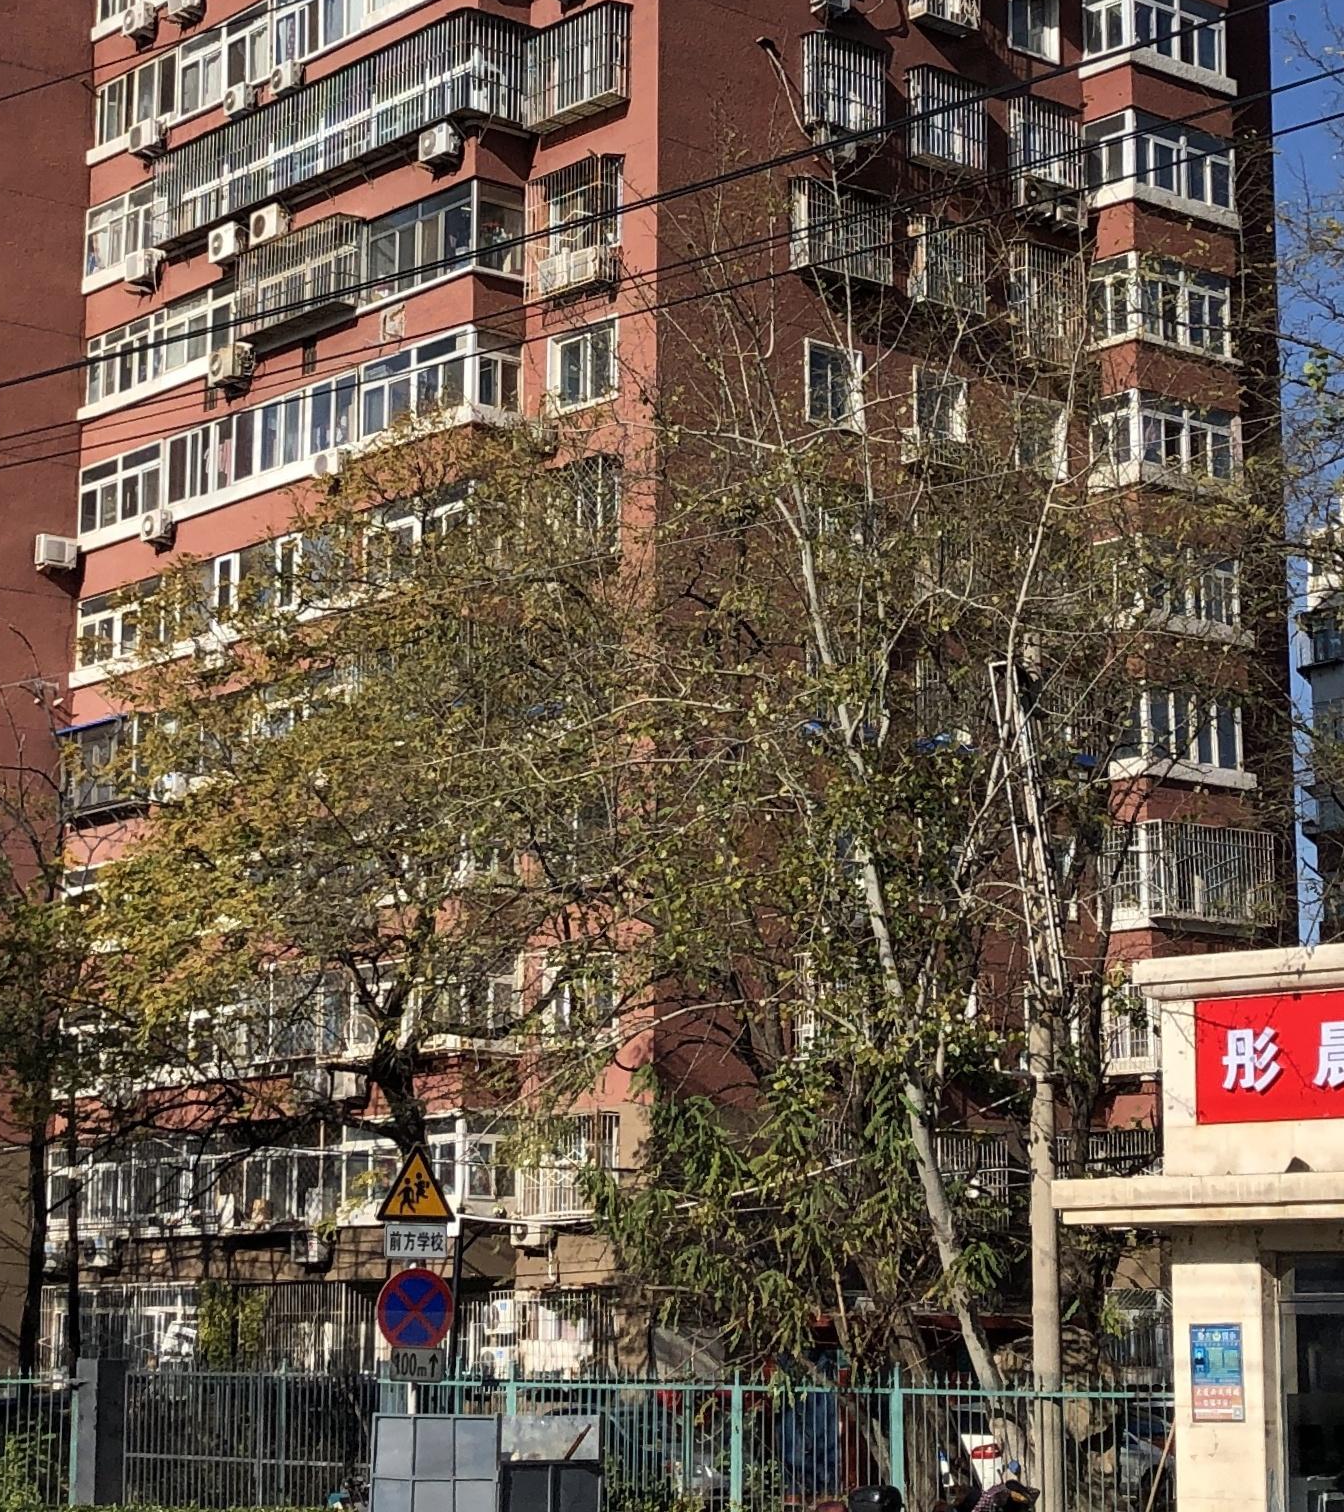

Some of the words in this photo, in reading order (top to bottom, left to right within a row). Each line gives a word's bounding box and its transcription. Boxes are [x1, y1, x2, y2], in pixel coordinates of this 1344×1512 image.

[389, 1231, 444, 1252] 前方学校
[394, 1352, 427, 1378] 100m
